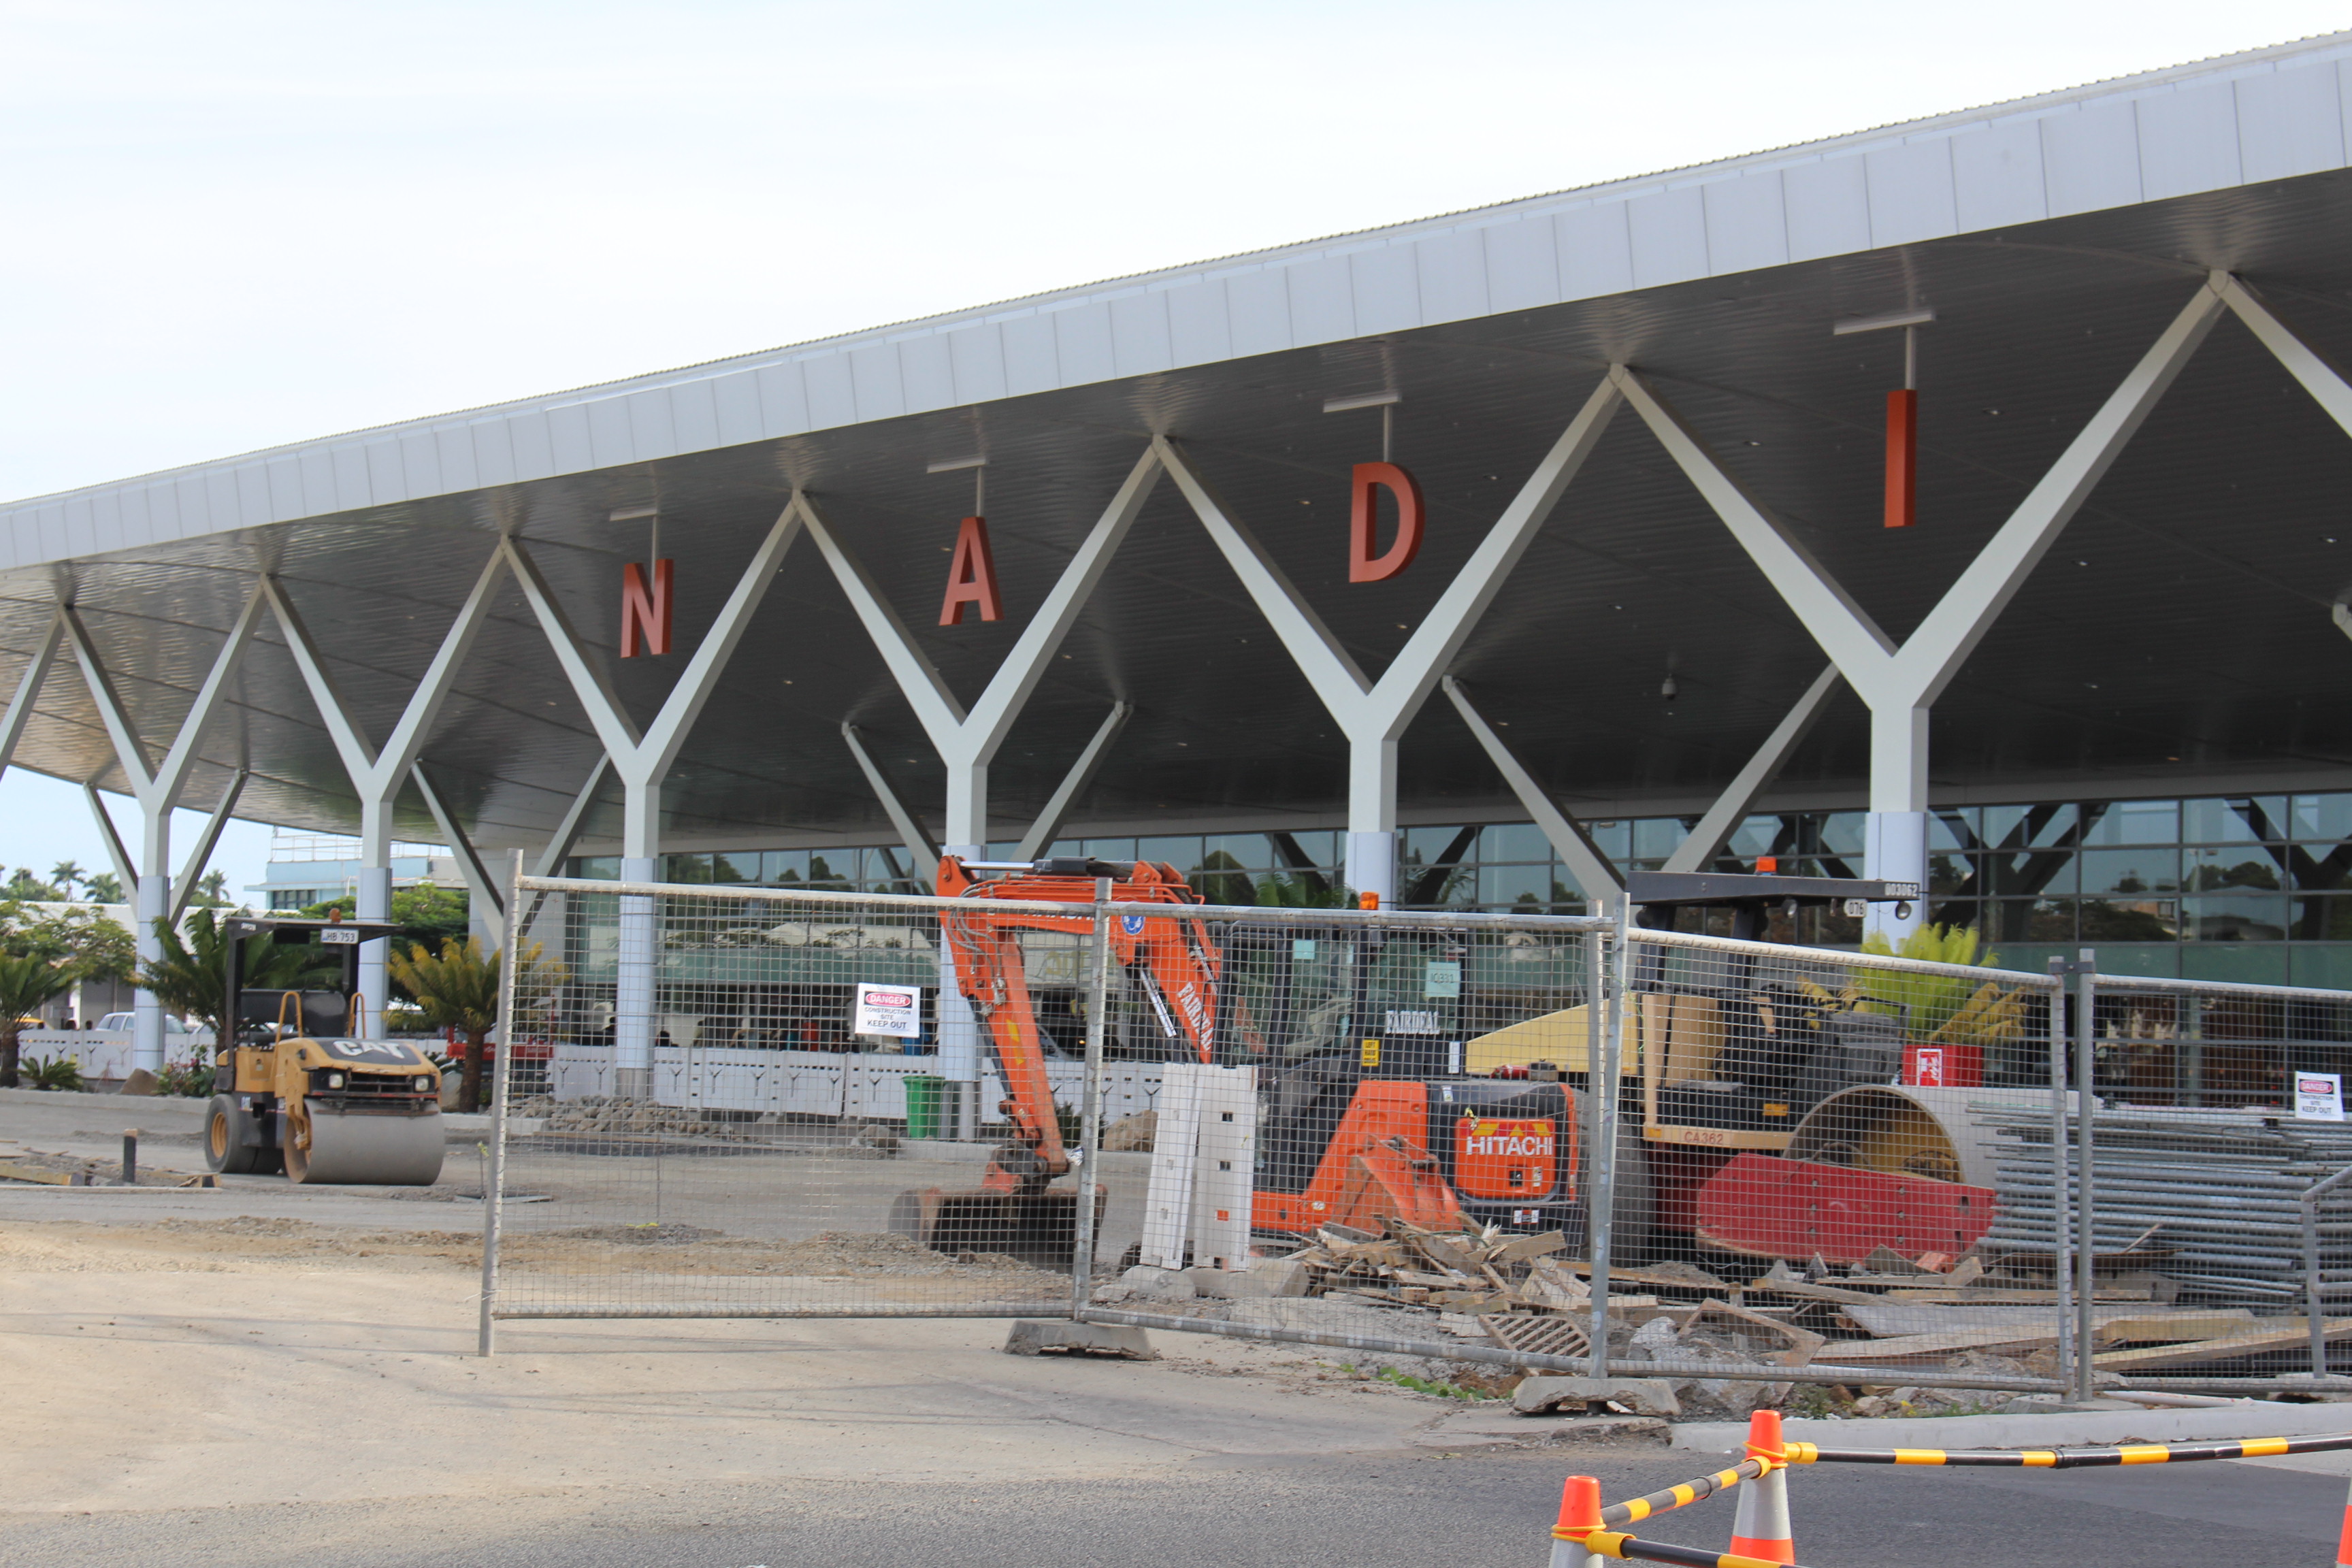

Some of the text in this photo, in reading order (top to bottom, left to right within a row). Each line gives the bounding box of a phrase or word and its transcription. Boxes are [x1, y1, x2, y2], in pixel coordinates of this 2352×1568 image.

[340, 932, 355, 942] 753
[869, 994, 906, 1004] DANGER
[1178, 981, 1213, 1051] FAIRDEAL
[1386, 1010, 1441, 1034] FAIRDEAL
[333, 1040, 405, 1059] CAT
[2301, 1082, 2328, 1090] DANGER
[1466, 1136, 1553, 1156] HITACHI
[1684, 1131, 1723, 1145] CA362
